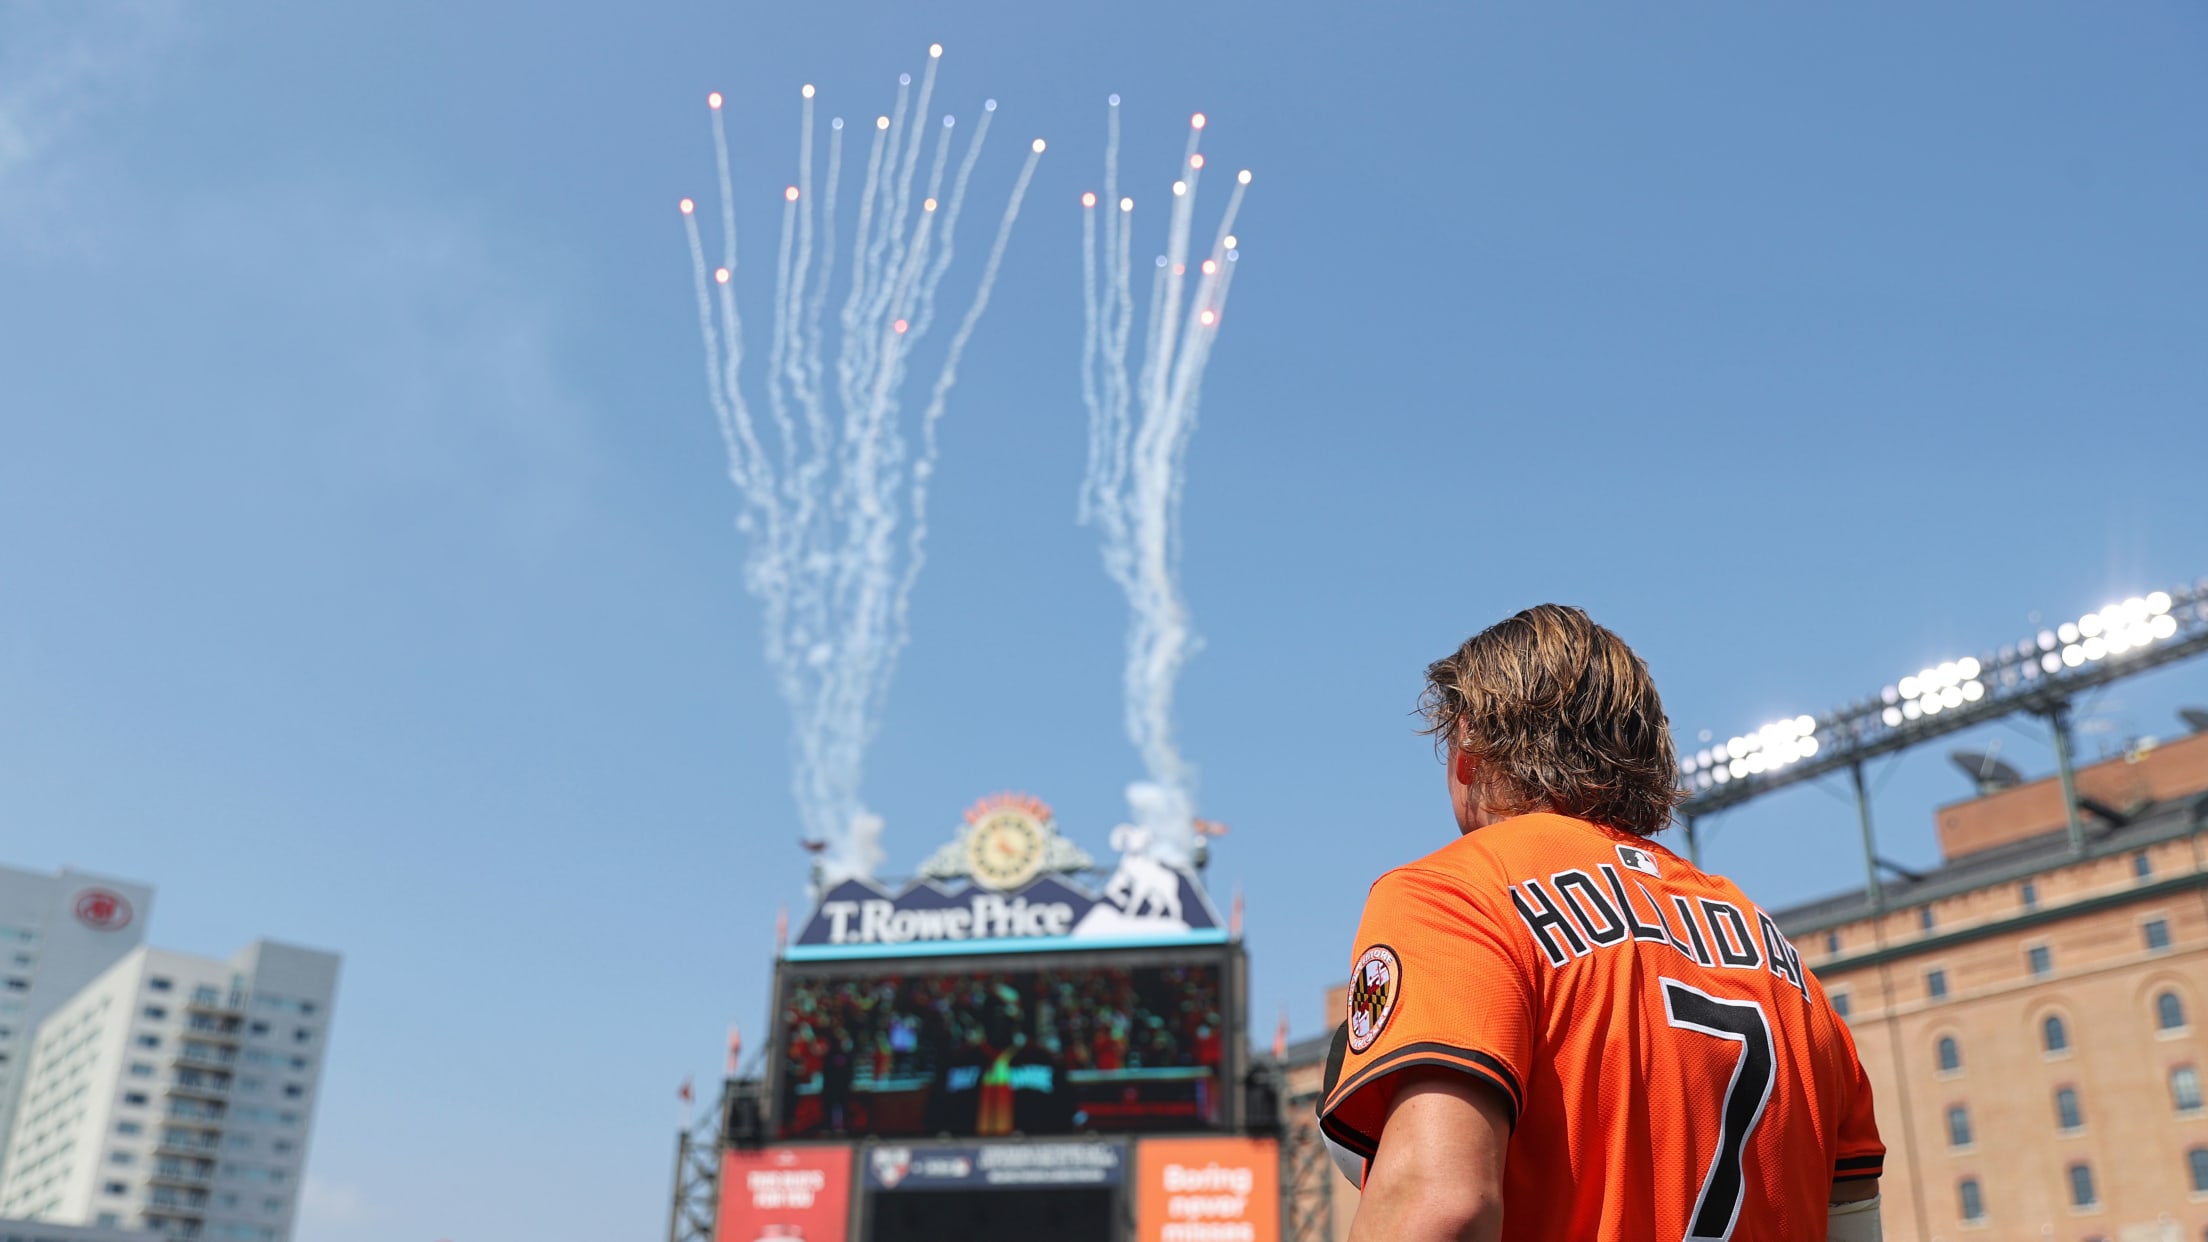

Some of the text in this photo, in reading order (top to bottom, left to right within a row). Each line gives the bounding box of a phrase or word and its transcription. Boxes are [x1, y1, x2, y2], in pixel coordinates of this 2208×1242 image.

[1508, 863, 1812, 1005] HOLLIDAY
[1658, 976, 1777, 1242] 7
[1162, 1162, 1253, 1197] Boring
[1167, 1194, 1248, 1219] never
